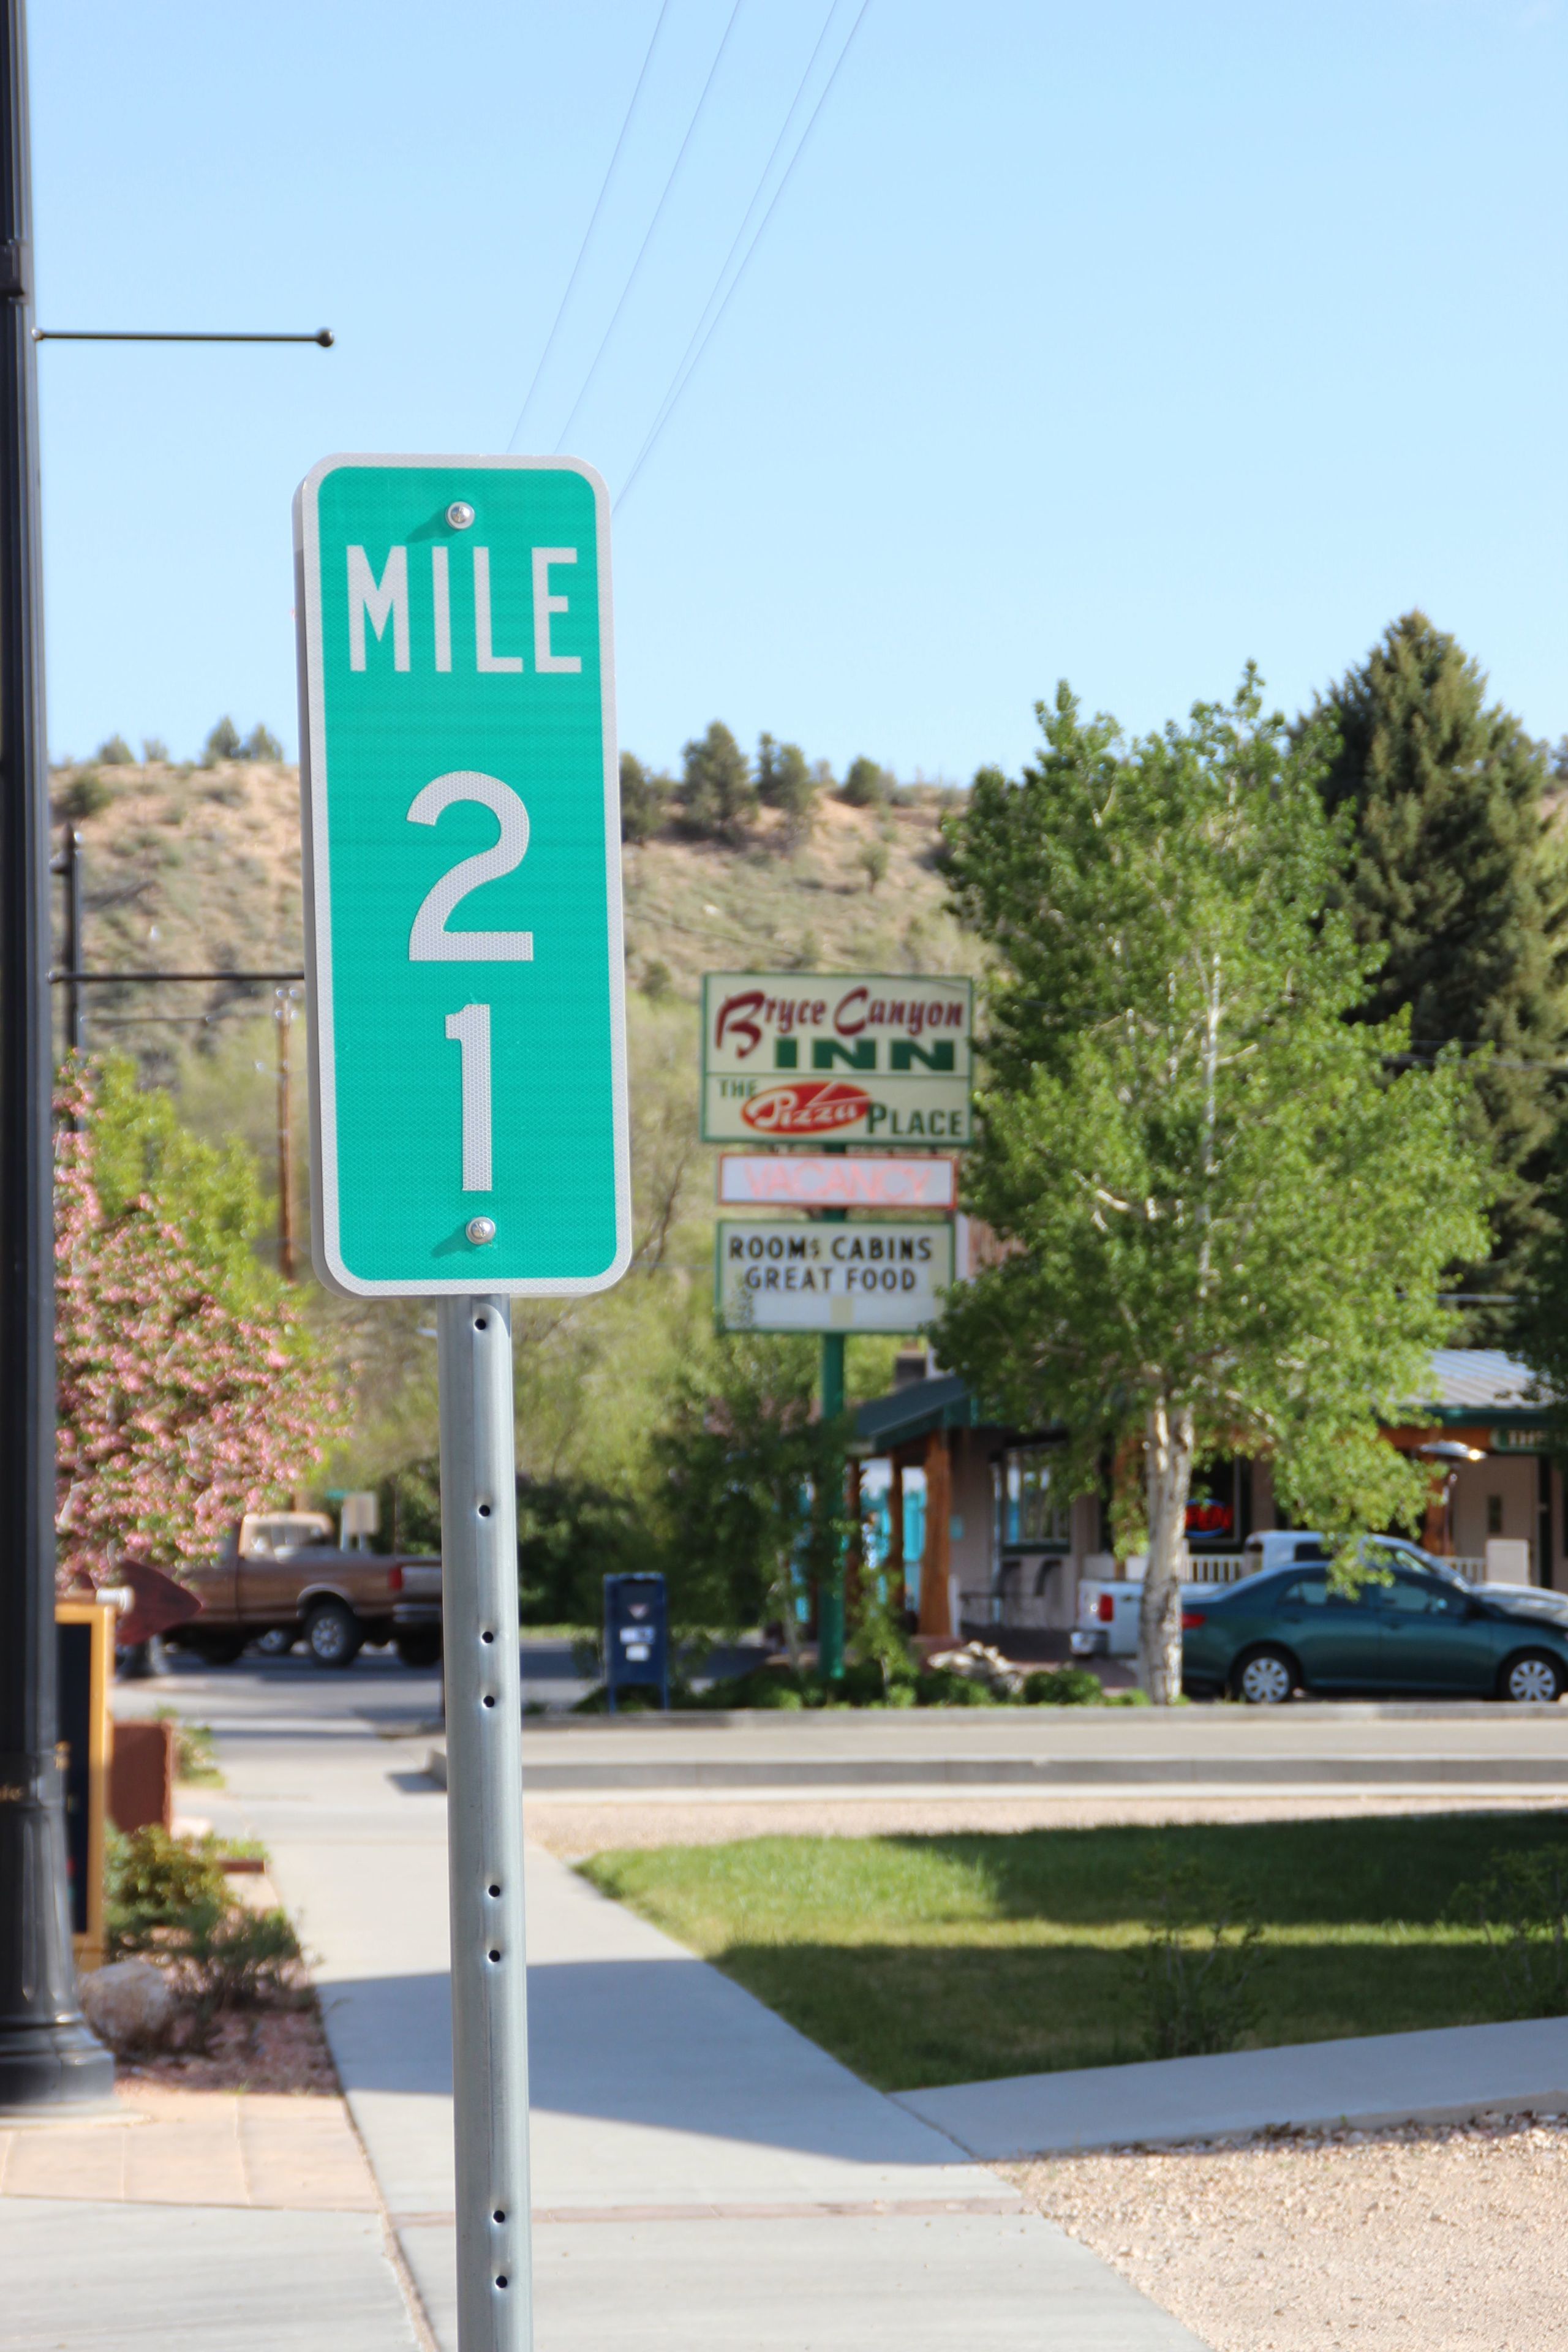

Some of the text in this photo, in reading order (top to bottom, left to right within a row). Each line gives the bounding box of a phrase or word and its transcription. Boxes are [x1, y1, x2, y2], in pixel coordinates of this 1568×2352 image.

[346, 545, 582, 673] MILE
[405, 769, 534, 962] 2
[715, 986, 963, 1059] Bryce Canyon
[774, 1037, 955, 1071] INN
[445, 1003, 492, 1191] 1
[718, 1078, 963, 1136] THE Pizza PLACE
[744, 1160, 932, 1201] VACANCY
[831, 1235, 933, 1261] CABINS
[744, 1266, 917, 1292] GREAT FOOD
